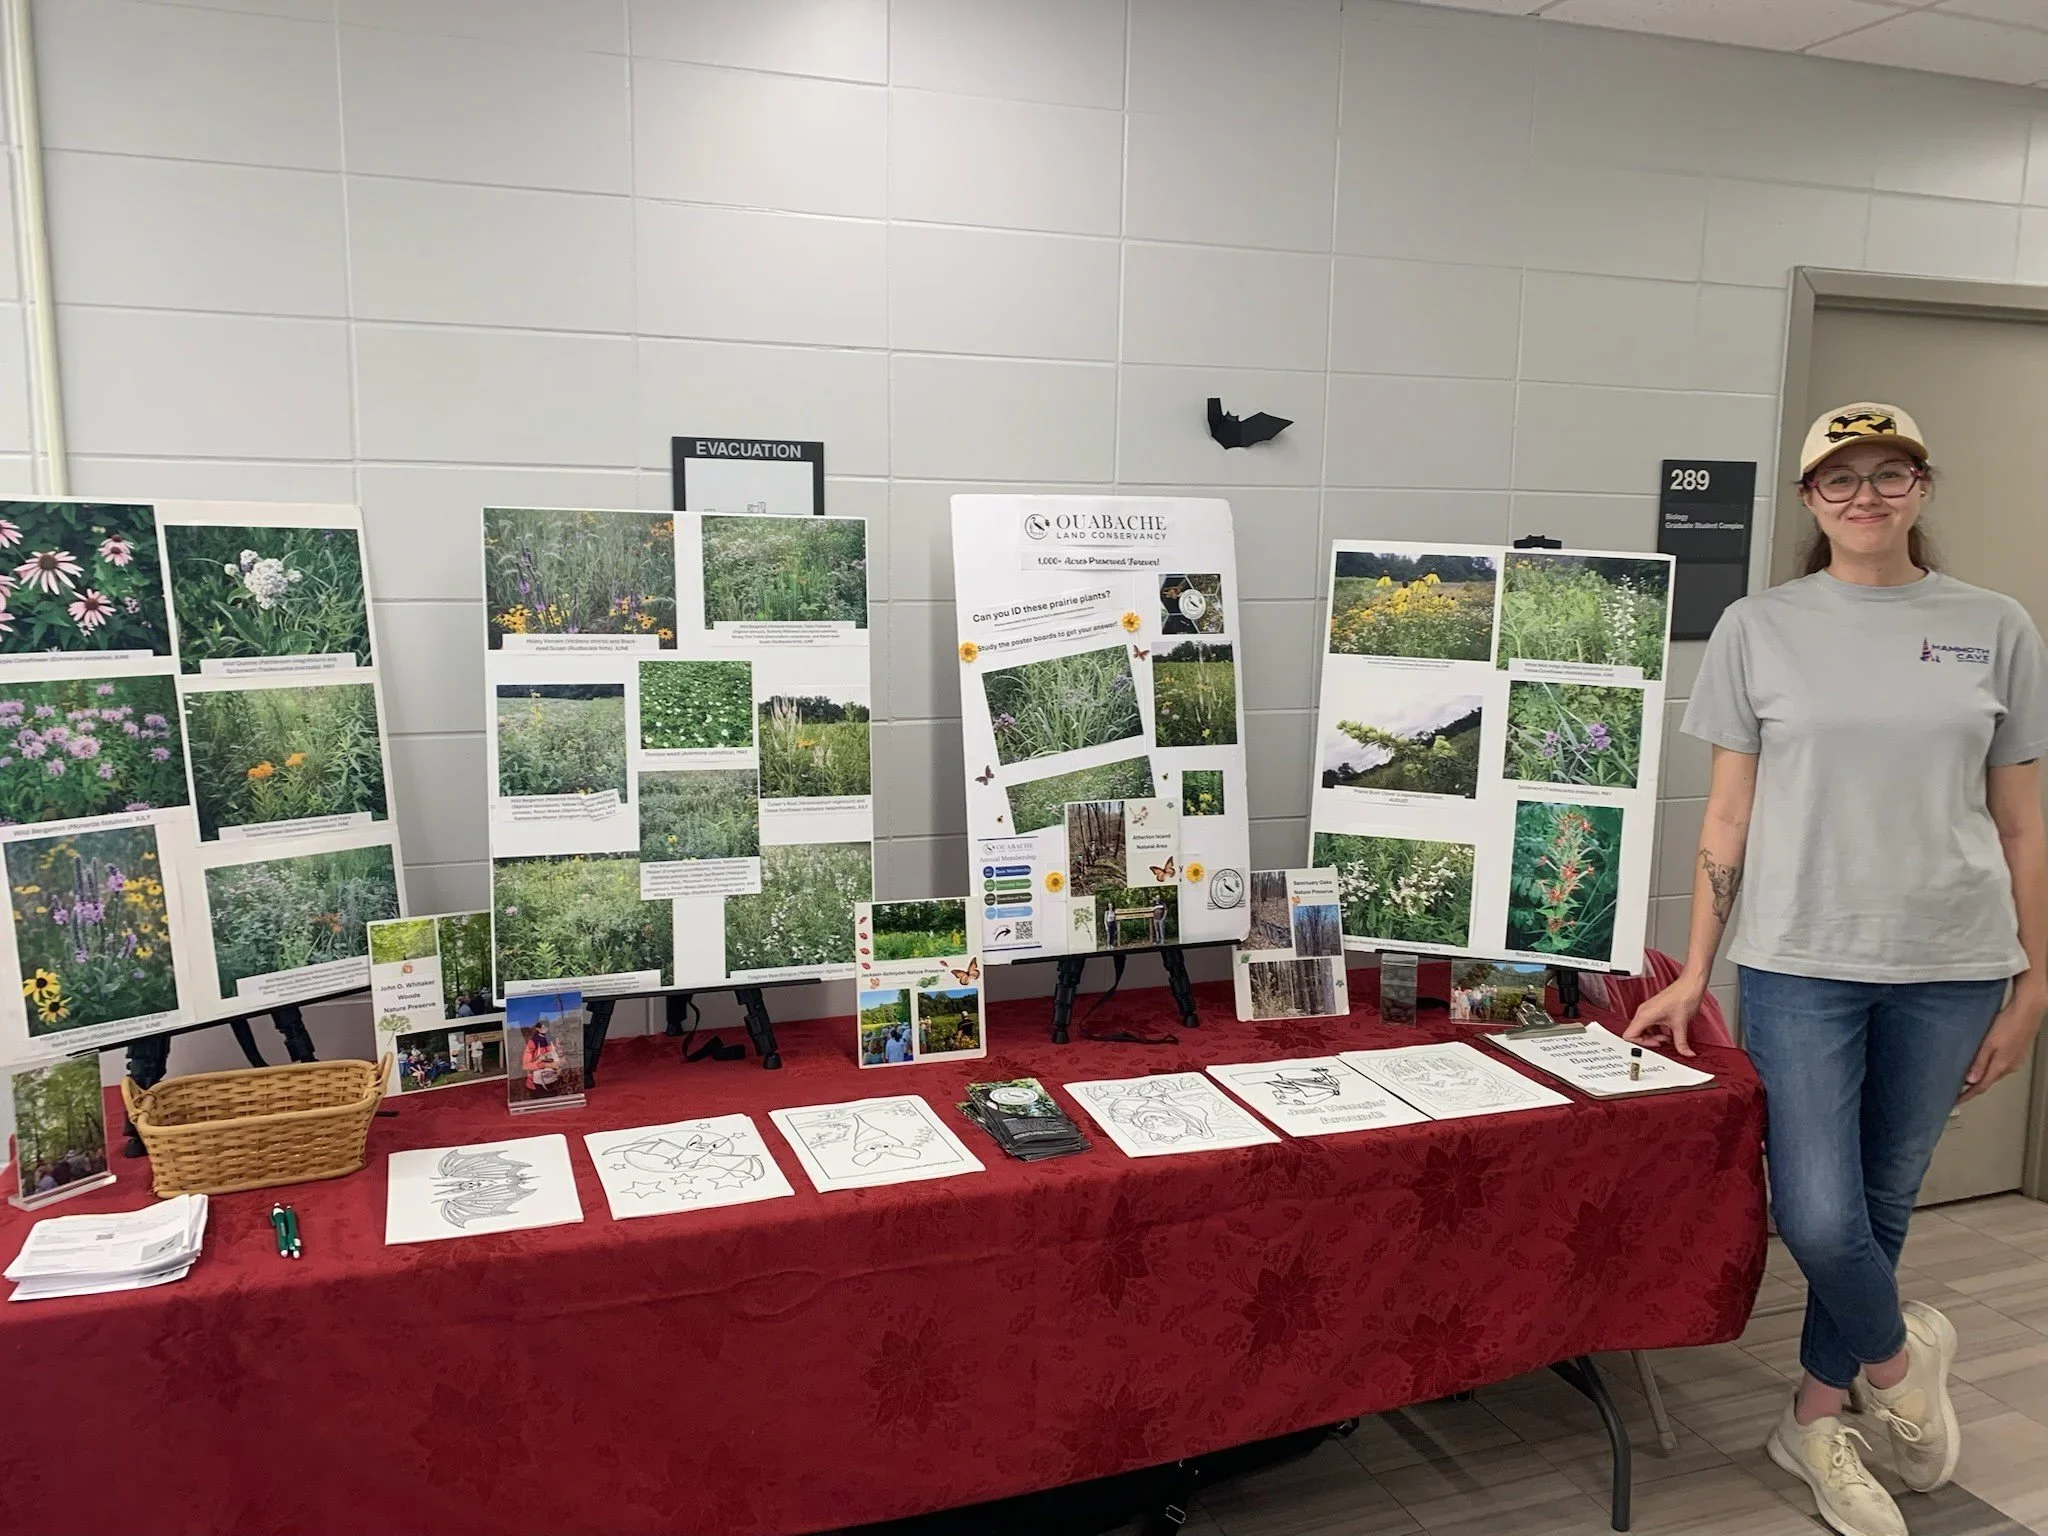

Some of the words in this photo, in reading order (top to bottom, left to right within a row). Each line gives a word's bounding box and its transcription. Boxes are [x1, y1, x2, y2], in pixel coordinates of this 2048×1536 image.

[696, 441, 801, 458] EVACUATION
[1670, 469, 1710, 490] 289
[1665, 513, 1689, 521] Biology
[1056, 514, 1167, 530] OUABACHE
[1719, 522, 1744, 530] Complex
[1091, 532, 1167, 540] CONSERVANCY
[1064, 557, 1088, 565] Acres
[1088, 557, 1126, 565] Preserved
[1127, 558, 1160, 566] Forever!
[973, 613, 992, 623] Can
[992, 610, 1010, 620] you
[1011, 606, 1022, 616] ID
[1023, 603, 1048, 613] these
[1049, 597, 1078, 610] prairie
[1079, 590, 1111, 604] plants?
[977, 643, 997, 653] Study
[998, 640, 1010, 648] the
[1011, 637, 1032, 647] poster
[1033, 632, 1057, 642] boards
[1066, 629, 1077, 637] get
[1078, 626, 1092, 635] your
[1932, 644, 1990, 654] MAMMOTH
[1956, 653, 1990, 661] CAVE
[405, 980, 435, 988] Whitaker
[397, 992, 421, 1000] Woods
[407, 1002, 436, 1010] Preserve
[1540, 1043, 1578, 1053] guess
[1579, 1039, 1601, 1047] the
[1550, 1049, 1599, 1058] number
[1583, 1062, 1622, 1070] seeds
[1578, 1072, 1604, 1080] this
